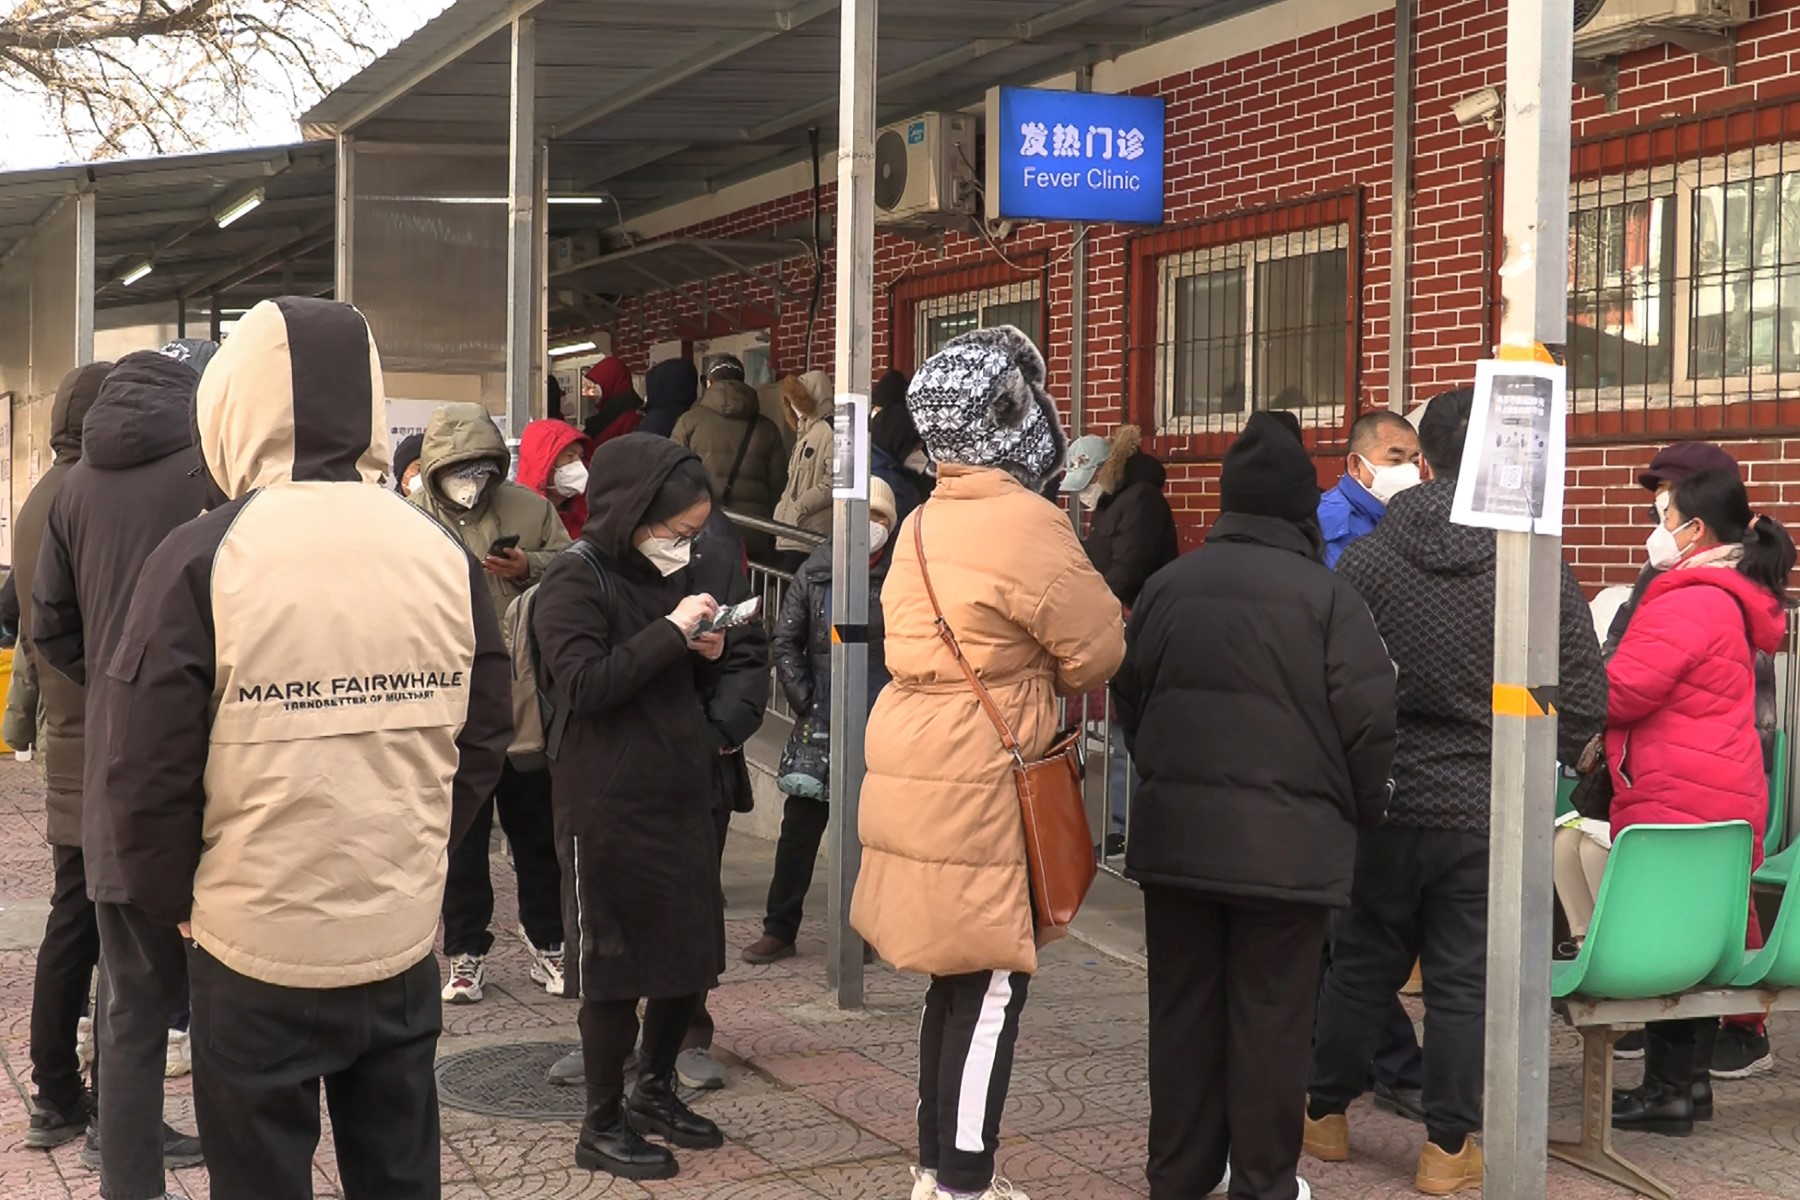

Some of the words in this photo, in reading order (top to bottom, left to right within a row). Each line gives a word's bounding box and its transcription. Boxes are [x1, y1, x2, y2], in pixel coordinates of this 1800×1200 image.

[1020, 121, 1145, 160] 发热门诊
[1024, 166, 1081, 188] Fever
[1087, 168, 1140, 191] Clinic
[239, 681, 321, 702] MARK
[332, 672, 464, 695] FAIRWHALE
